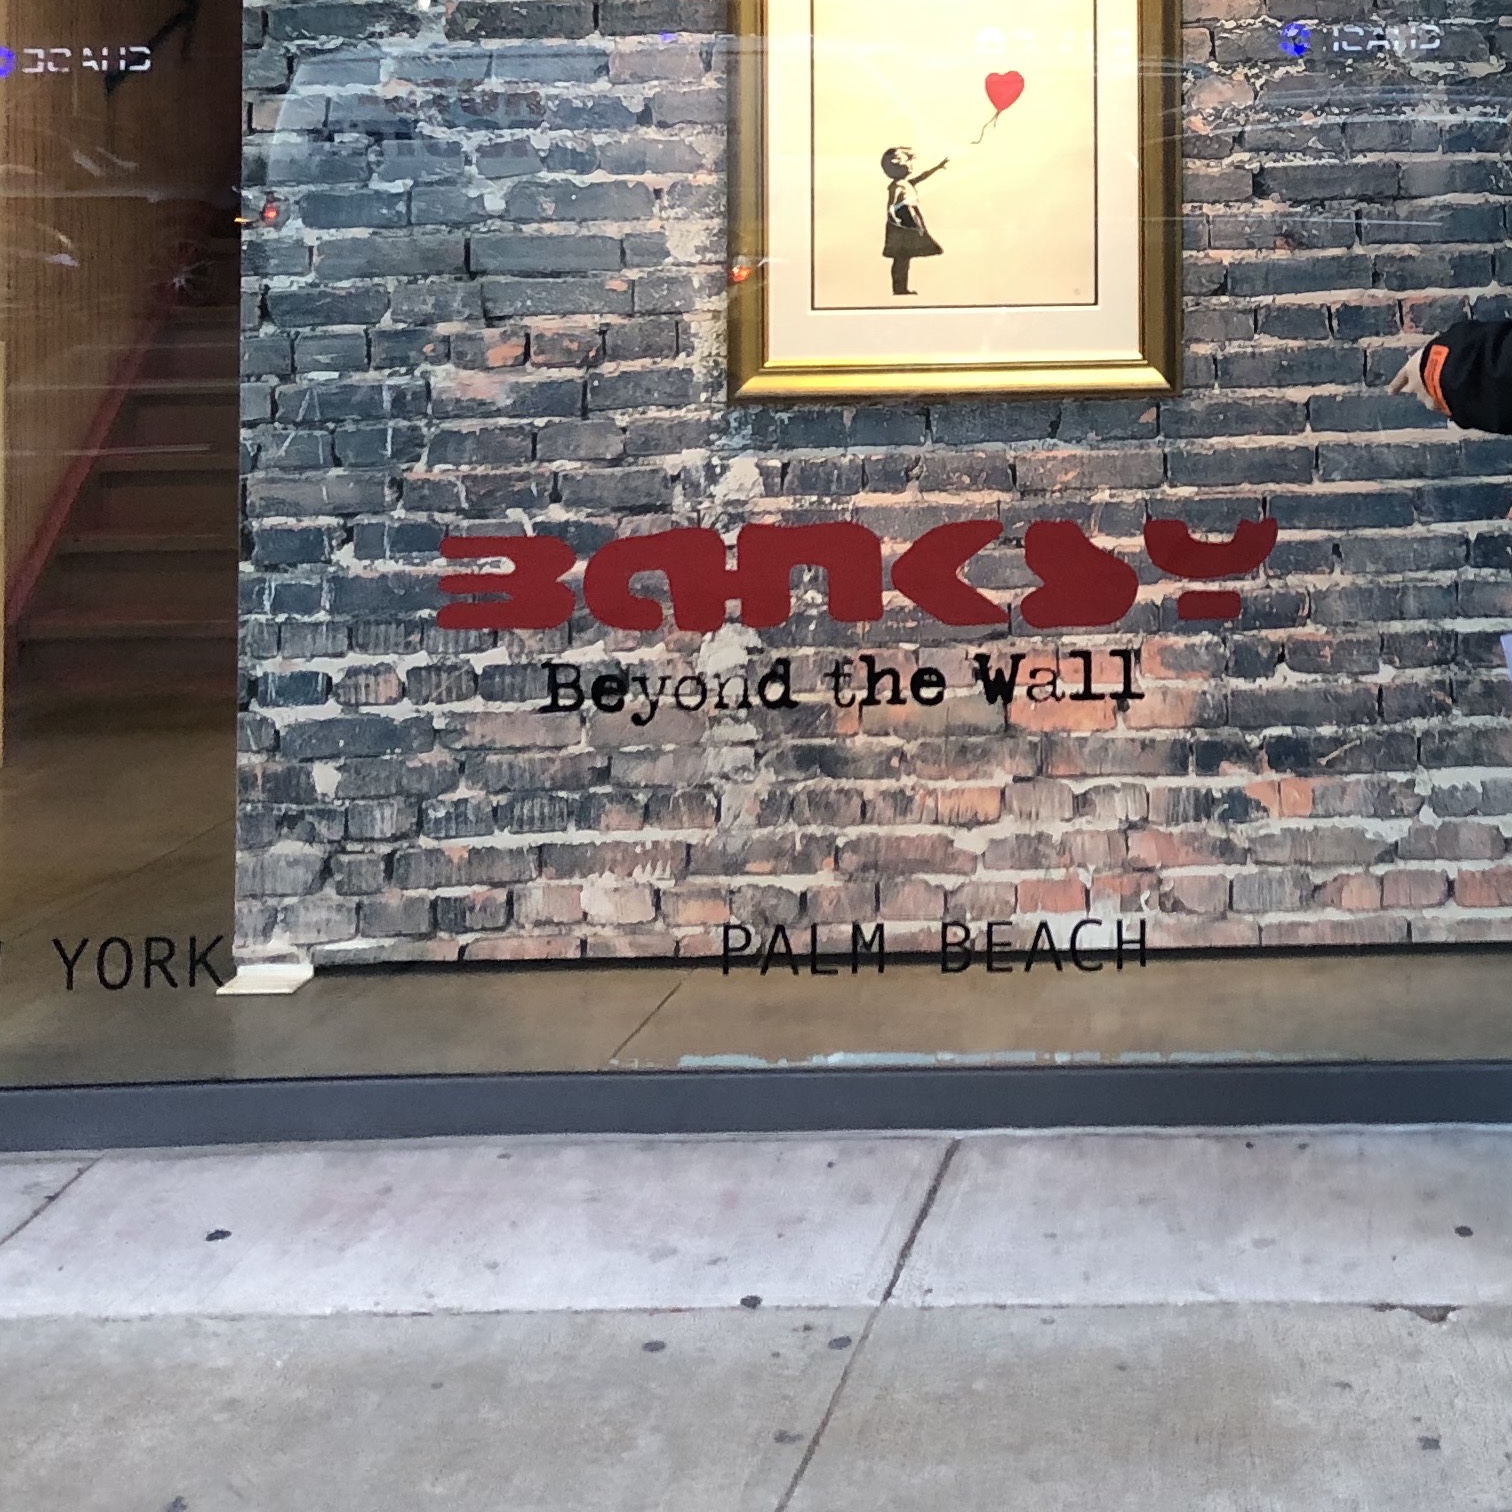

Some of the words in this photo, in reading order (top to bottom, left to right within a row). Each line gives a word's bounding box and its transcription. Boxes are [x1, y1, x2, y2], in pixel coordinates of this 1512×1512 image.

[537, 656, 799, 727] Beyond
[823, 653, 947, 708] the
[972, 648, 1146, 706] Wall
[52, 934, 226, 990] YORK
[721, 920, 886, 977] PALM
[939, 917, 1148, 976] BEACH
